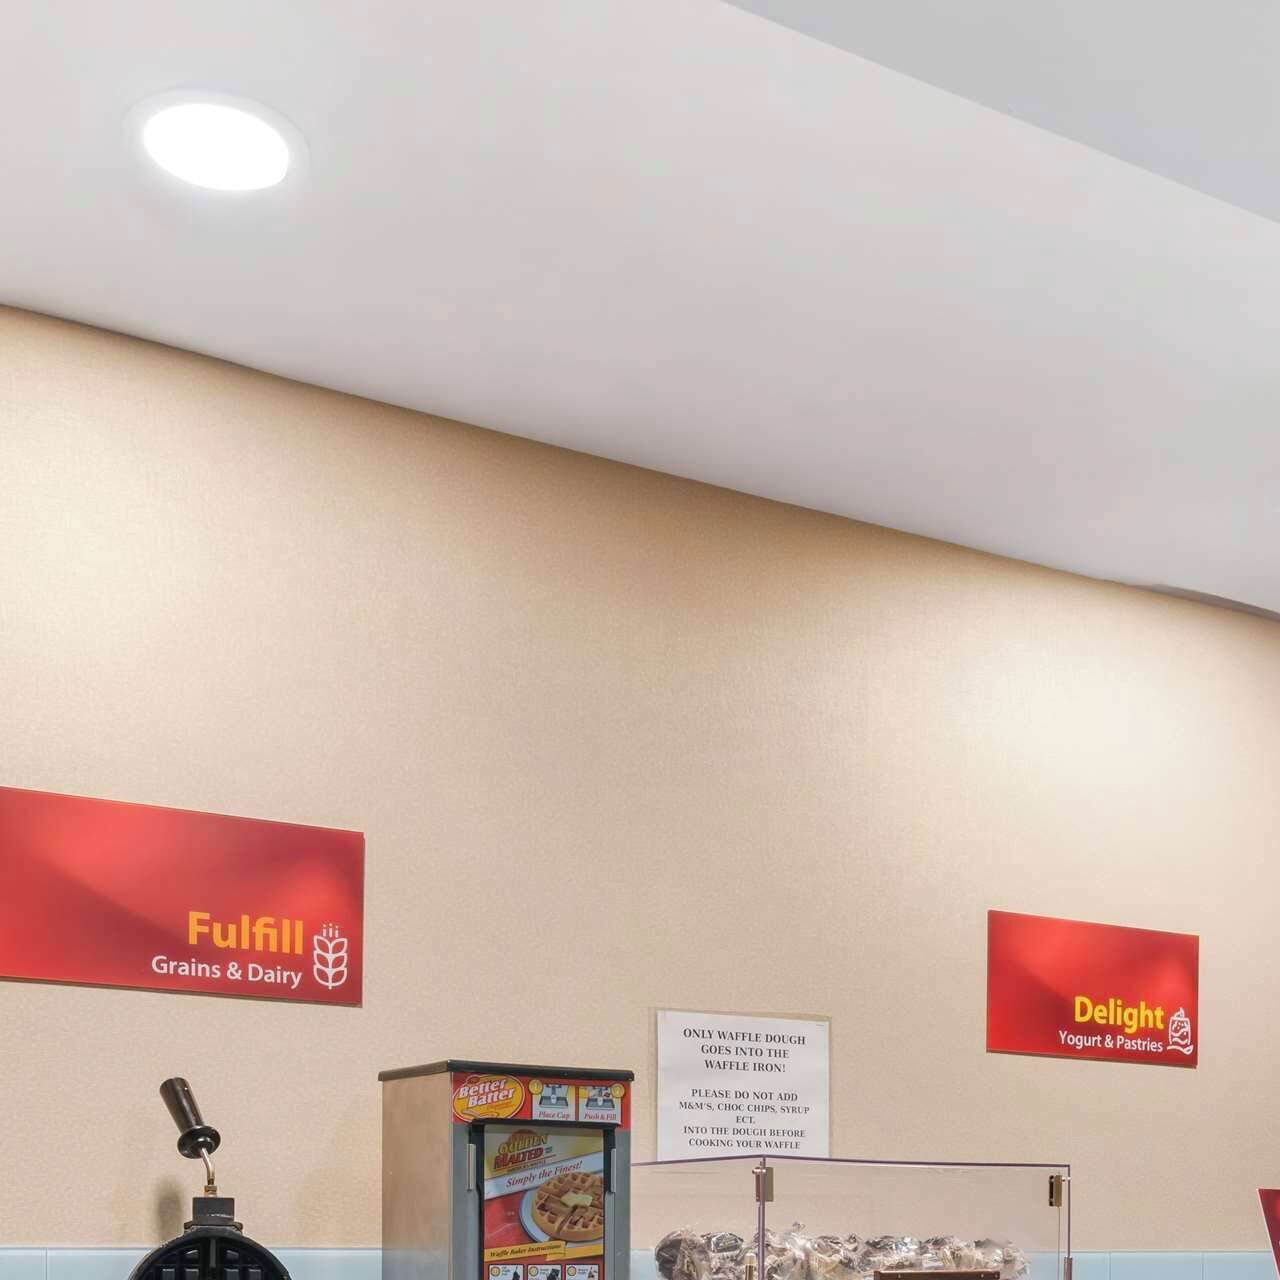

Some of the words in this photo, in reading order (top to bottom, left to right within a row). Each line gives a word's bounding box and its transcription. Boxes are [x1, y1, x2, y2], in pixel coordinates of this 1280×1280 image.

[188, 910, 304, 955] Fulfill
[151, 955, 221, 979] Grains
[226, 961, 243, 980] &
[248, 963, 303, 990] Dairy
[1074, 995, 1165, 1034] Delight
[683, 1027, 715, 1040] ONLY
[716, 1030, 762, 1044] WAFFLE
[765, 1033, 806, 1046] DOUGH
[1058, 1030, 1102, 1049] Yogurt
[1104, 1034, 1114, 1048] &
[1116, 1035, 1164, 1052] Pastries
[700, 1044, 732, 1056] GOES
[734, 1046, 764, 1058] INTO
[766, 1048, 790, 1059] THE
[704, 1059, 750, 1072] WAFFLE
[752, 1061, 786, 1073] IRON!
[459, 1080, 506, 1099] Better
[468, 1088, 515, 1107] Batter
[690, 1088, 731, 1099] PLEASE
[734, 1089, 750, 1100] DO
[752, 1090, 773, 1101] NOT
[776, 1091, 798, 1102] ADD
[717, 1102, 745, 1112] CHOC
[779, 1104, 810, 1115] SYRUP
[683, 1125, 708, 1135] INTO
[710, 1126, 730, 1136] THE
[732, 1127, 767, 1138] DOUGH
[769, 1128, 806, 1138] BEFORE
[688, 1138, 734, 1148] COOKING
[736, 1139, 762, 1149] YOUR
[764, 1140, 801, 1150] WAFFLE
[494, 1147, 545, 1169] MALTED
[505, 1172, 537, 1188] Simply
[538, 1168, 553, 1179] the
[554, 1160, 583, 1176] Finest!
